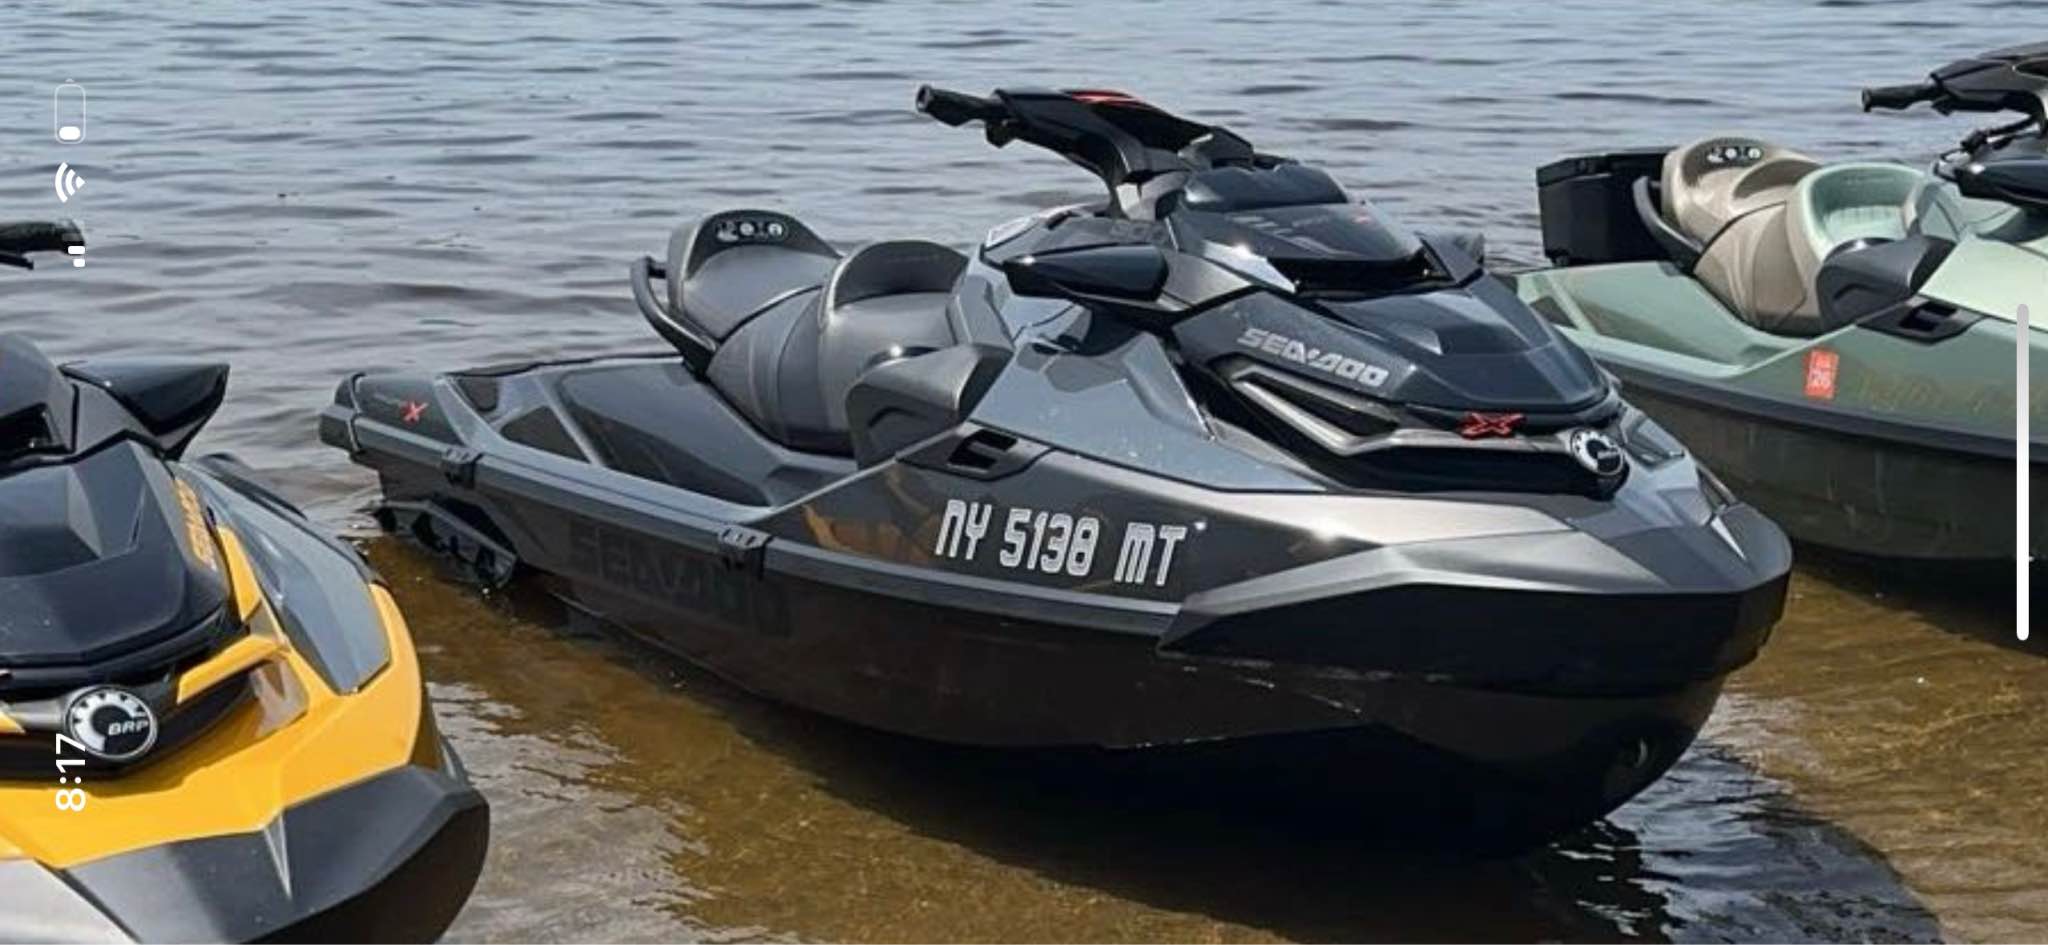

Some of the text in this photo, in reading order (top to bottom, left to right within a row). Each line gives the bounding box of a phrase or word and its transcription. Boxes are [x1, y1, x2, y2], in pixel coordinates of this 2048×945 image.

[934, 499, 1188, 586] NY 5138 MT
[108, 720, 148, 736] BRP
